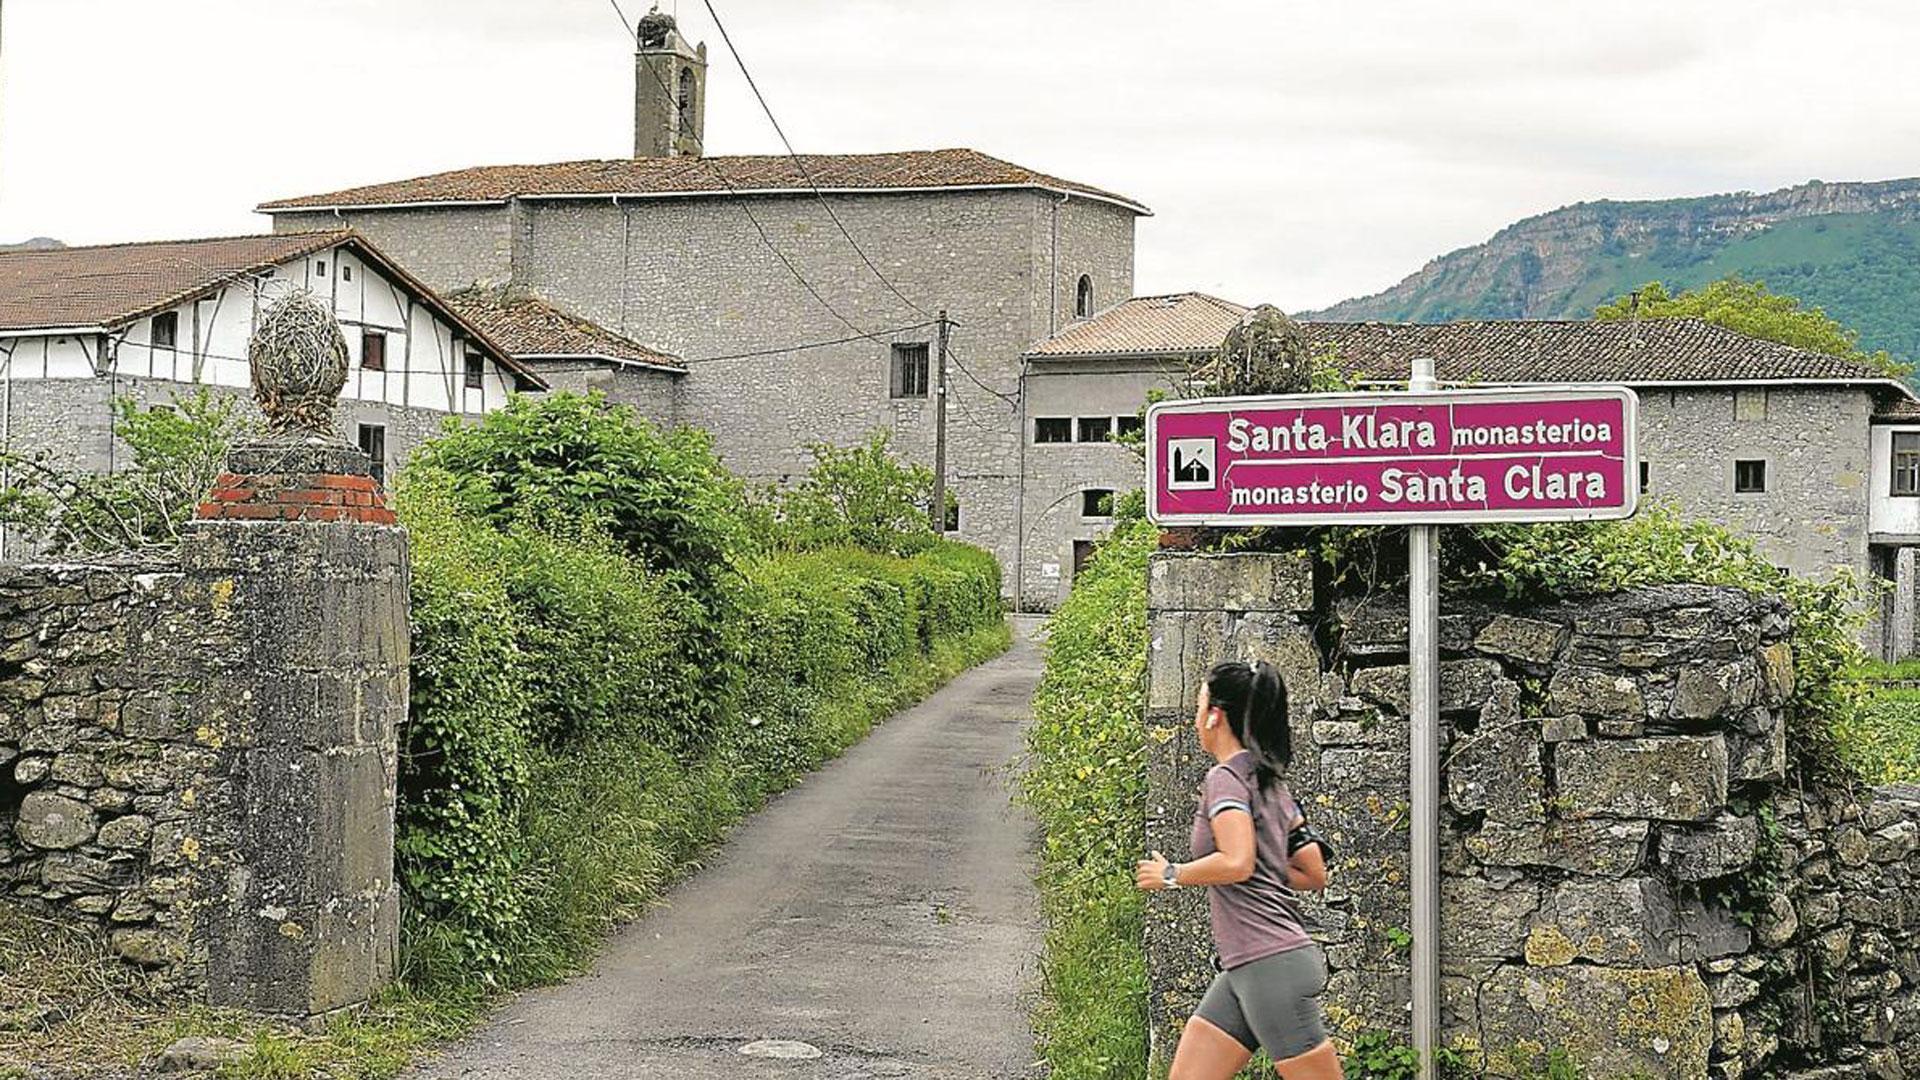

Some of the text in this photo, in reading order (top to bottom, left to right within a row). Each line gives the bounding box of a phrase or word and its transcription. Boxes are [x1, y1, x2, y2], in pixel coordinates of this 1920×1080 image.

[1228, 415, 1612, 452] Santa Klara monasterioa
[1231, 464, 1606, 505] monasterio Santa Clara
